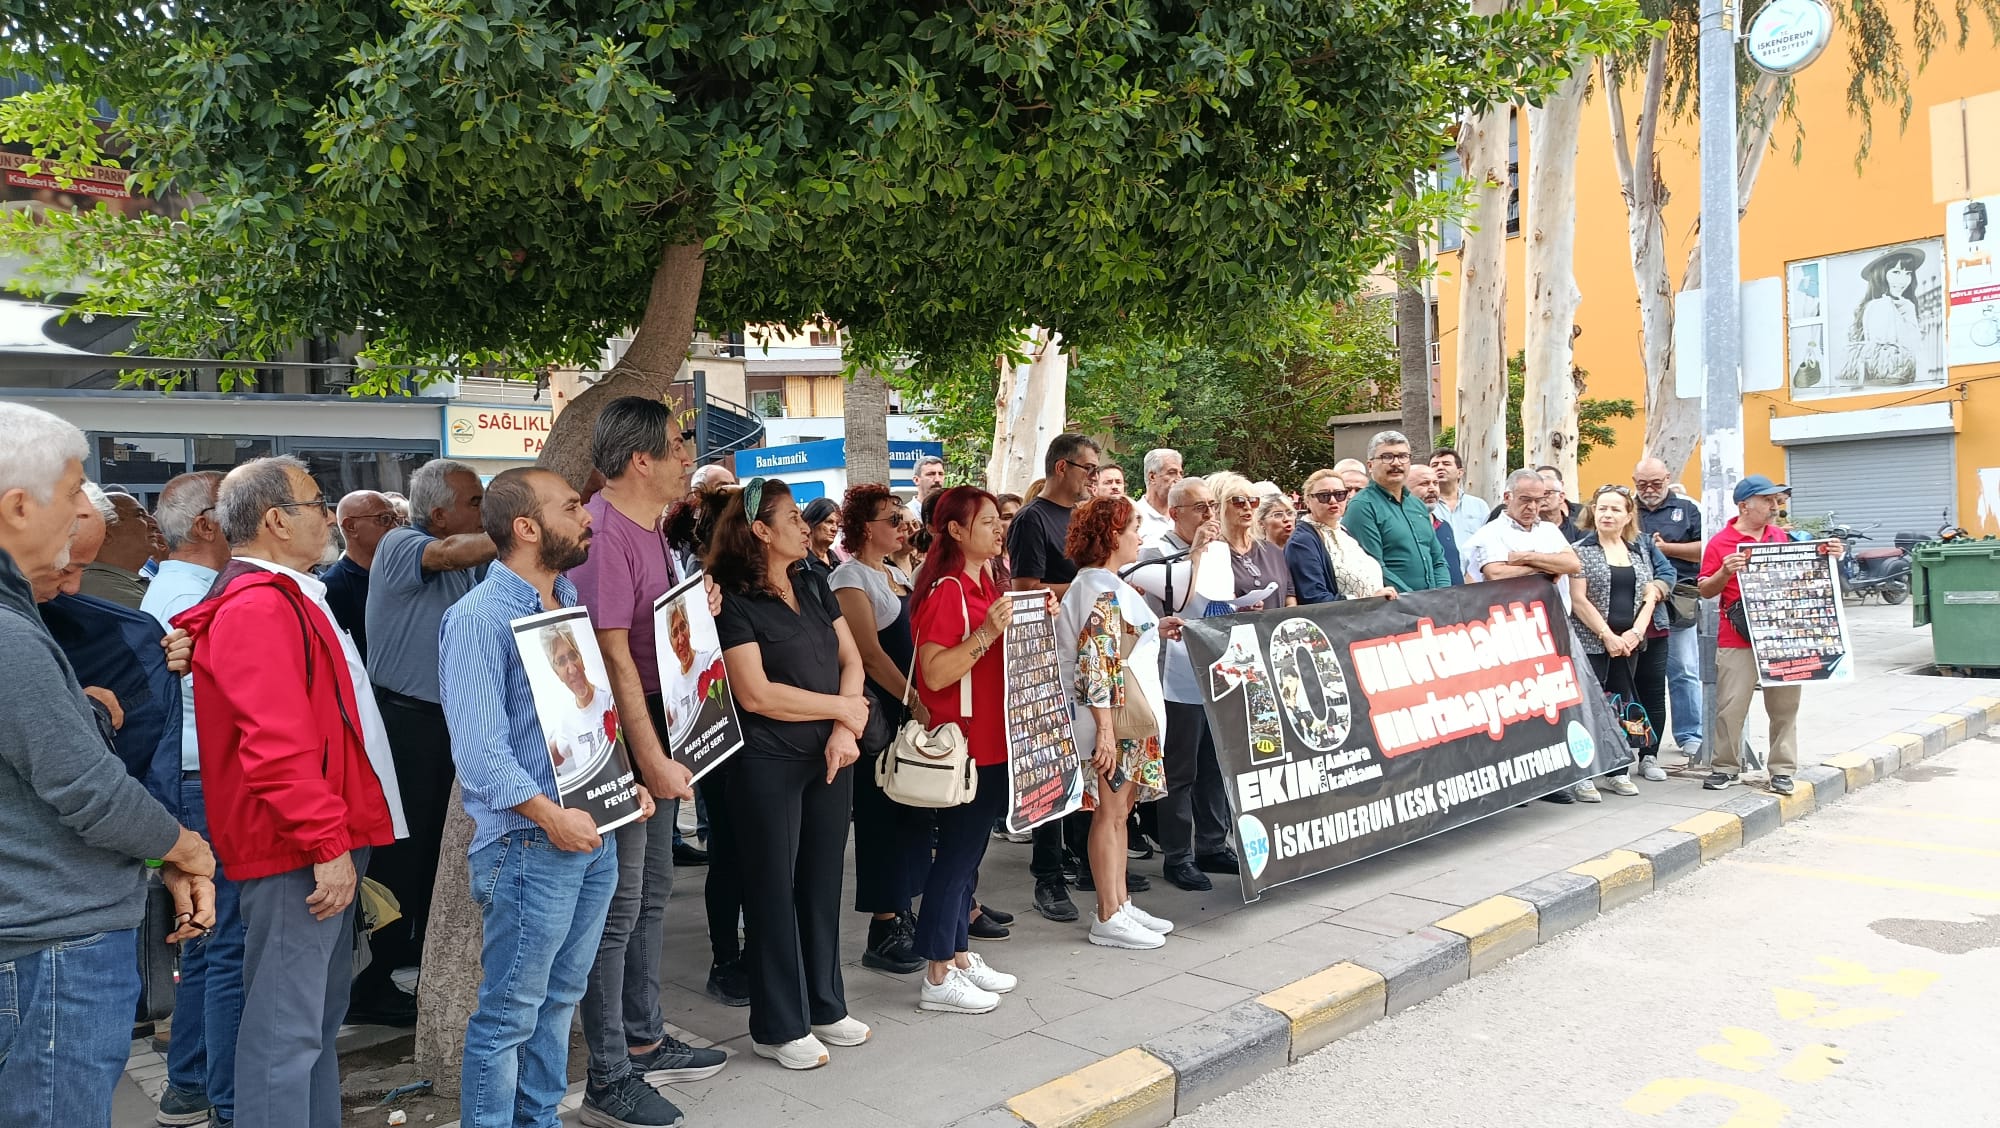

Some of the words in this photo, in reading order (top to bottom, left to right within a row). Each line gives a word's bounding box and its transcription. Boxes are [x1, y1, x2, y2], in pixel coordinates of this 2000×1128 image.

[756, 451, 808, 468] Bankamatik
[1353, 606, 1555, 695] unutmadık!
[1209, 617, 1351, 766] 10
[1373, 661, 1579, 751] unutmayacağız!
[684, 737, 702, 755] BARIŞ
[701, 716, 729, 743] ŞEHİDİMİZ
[694, 742, 710, 763] FEVZİ
[710, 732, 725, 749] SERT
[1318, 761, 1328, 789] 2015
[1325, 746, 1372, 771] Ankara
[587, 780, 617, 801] BARIŞ
[604, 788, 631, 809] FEVZİ
[1237, 752, 1329, 812] EKİM
[1274, 797, 1395, 860] İSKENDERUN
[1395, 788, 1438, 824] KESK
[1437, 764, 1501, 814] ŞUBELER
[1500, 741, 1571, 789] PLATFORMU
